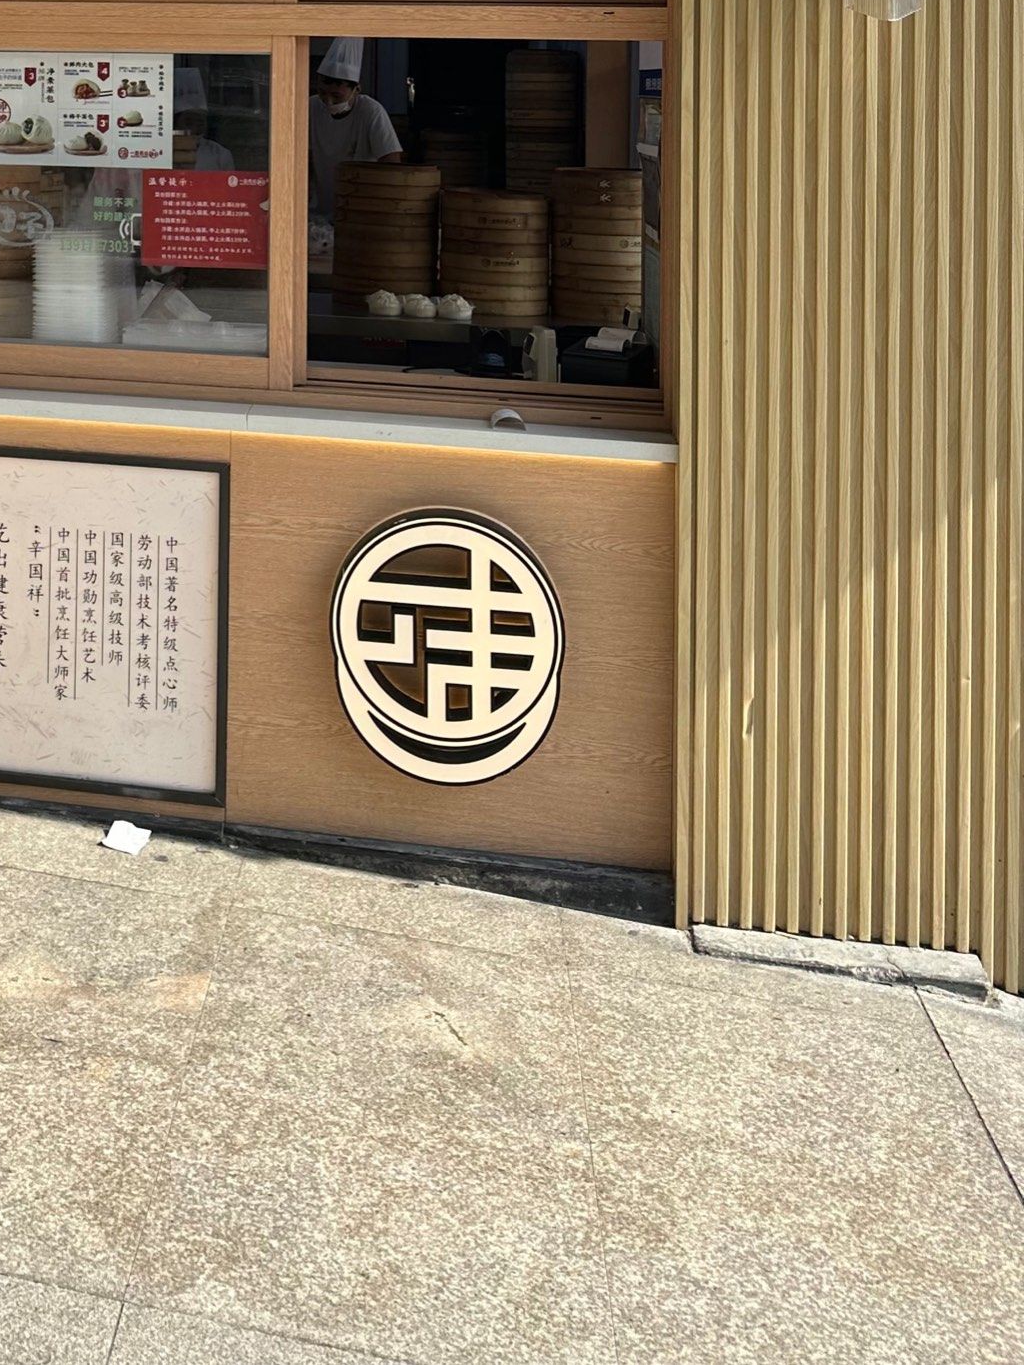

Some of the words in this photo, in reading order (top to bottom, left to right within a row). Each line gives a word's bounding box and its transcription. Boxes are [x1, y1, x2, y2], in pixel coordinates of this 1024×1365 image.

[54, 528, 71, 701] 中国首批烹饪大师家
[81, 530, 97, 683] 中国功勋烹饪艺术
[108, 532, 125, 666] 国家级高级技师
[135, 534, 153, 710] 劳动部技术考核评委
[162, 536, 179, 713] 中国著名特级点心师
